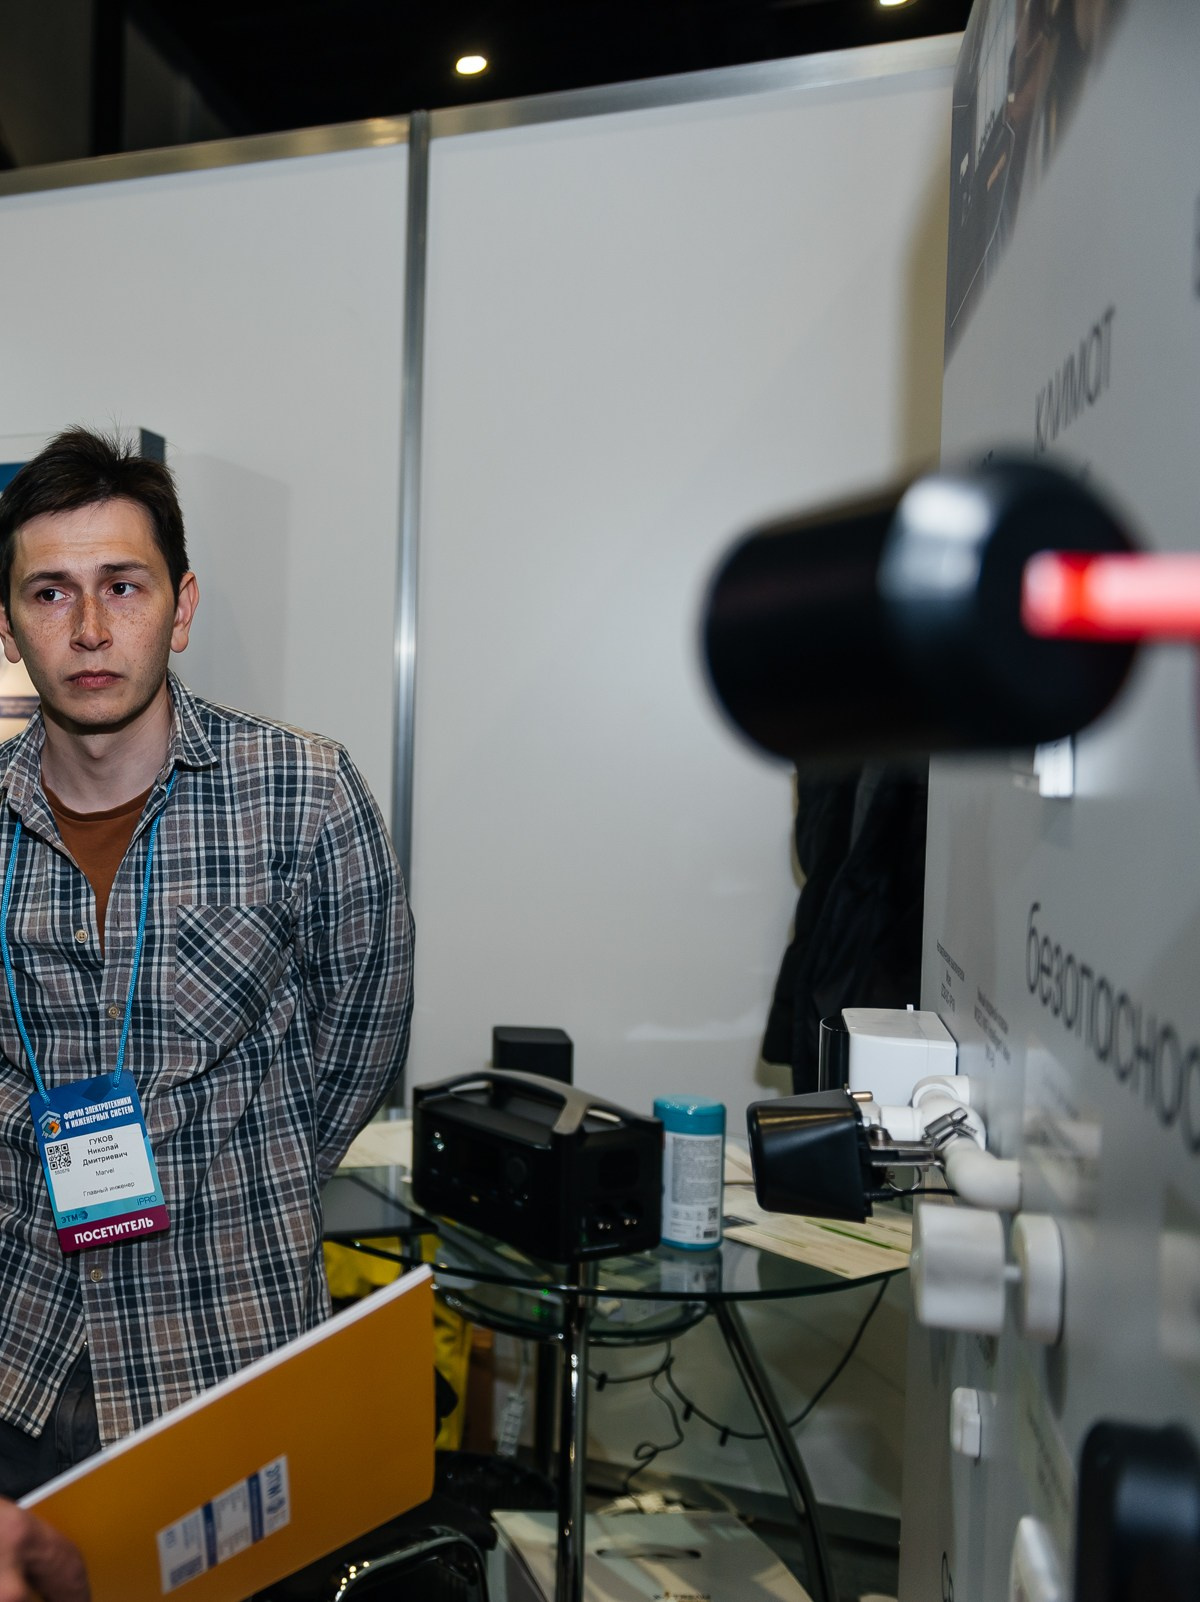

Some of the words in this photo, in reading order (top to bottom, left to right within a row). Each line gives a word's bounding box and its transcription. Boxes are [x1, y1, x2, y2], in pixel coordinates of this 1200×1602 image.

[63, 1108, 85, 1120] ФОРУМ
[84, 1095, 132, 1115] ЭЛЕКТРОТЕХНИКИ
[65, 1121, 70, 1130] И
[70, 1111, 110, 1128] ИНЖЕНЕРНЫХ
[110, 1104, 135, 1118] СИСТЕМ
[88, 1134, 114, 1145] ГУКОВ
[87, 1143, 119, 1155] Николай
[82, 1151, 128, 1167] Дмитриевич
[95, 1167, 115, 1176] Marvel
[83, 1186, 108, 1197] Главный
[109, 1181, 135, 1191] инженер
[61, 1213, 79, 1224] ЭТМ
[74, 1217, 154, 1244] ПОСЕТИТЕЛЬ
